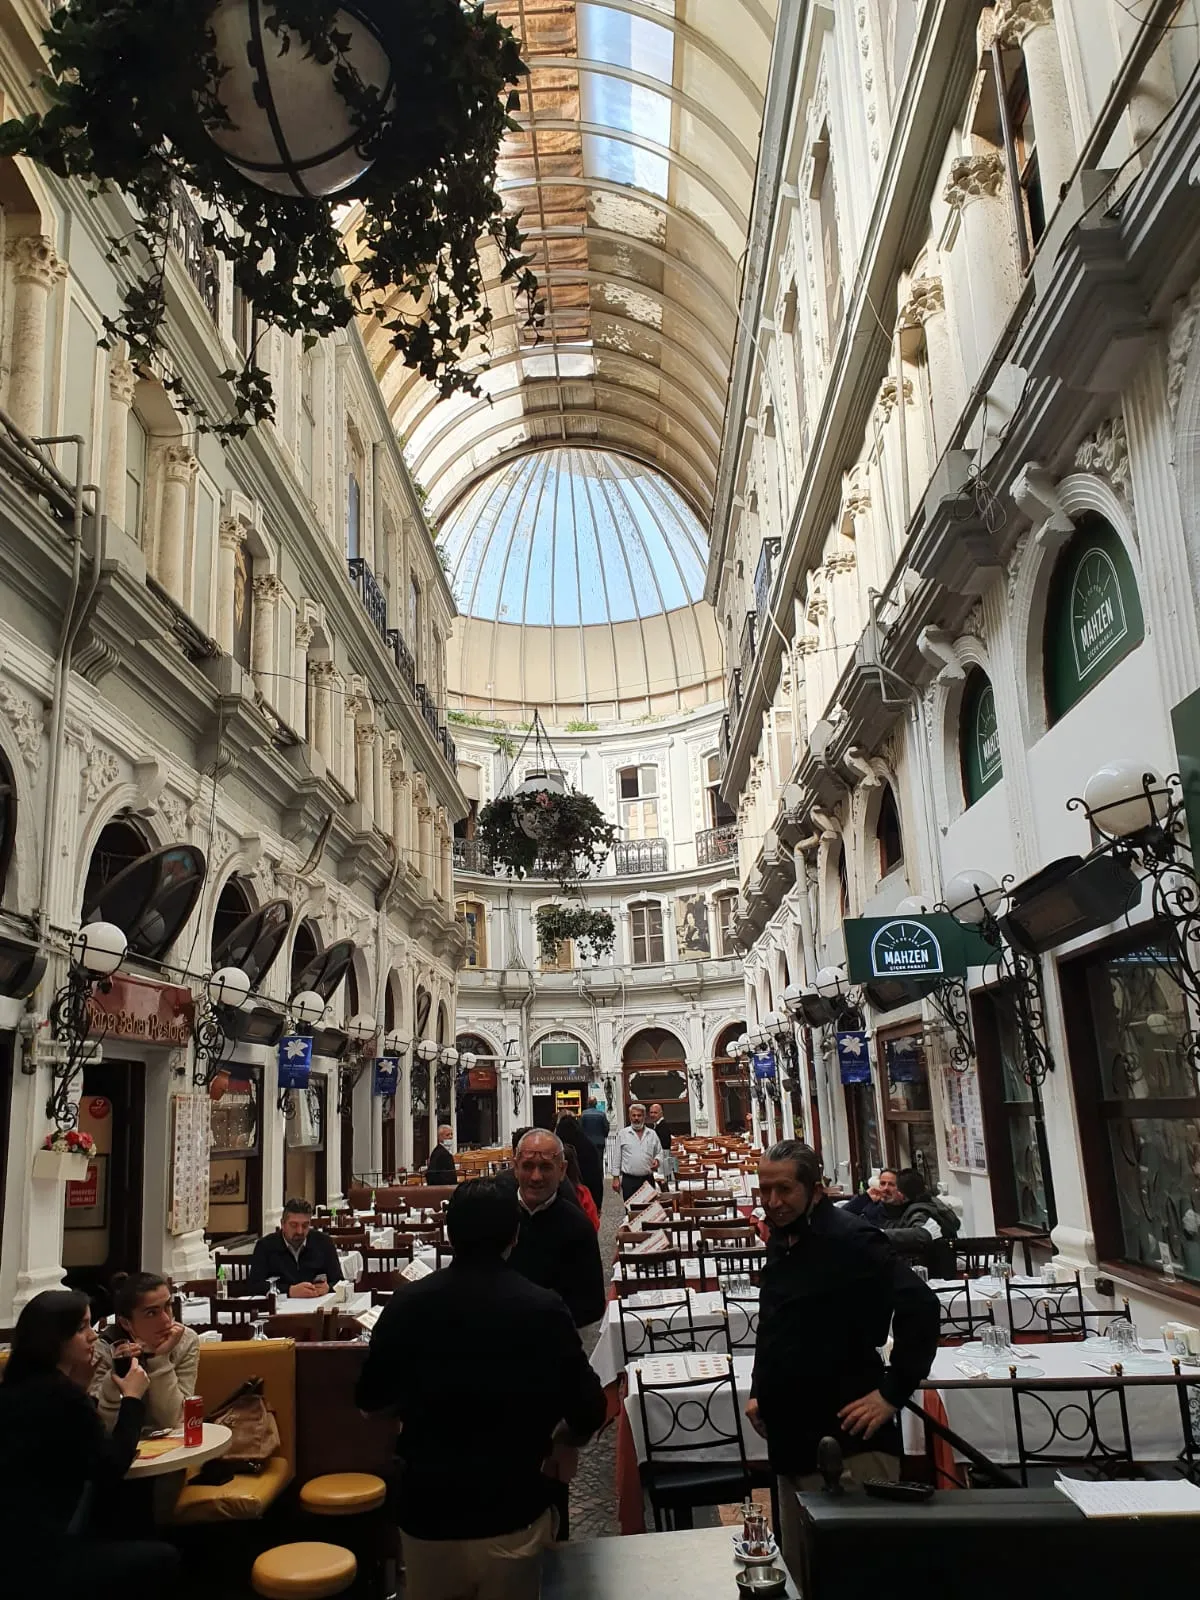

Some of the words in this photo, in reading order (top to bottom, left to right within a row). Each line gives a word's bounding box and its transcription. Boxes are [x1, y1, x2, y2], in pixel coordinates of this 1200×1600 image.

[1081, 596, 1114, 652] MAHZEN
[983, 728, 1001, 762] MAHZE
[884, 949, 929, 965] MAHZEN
